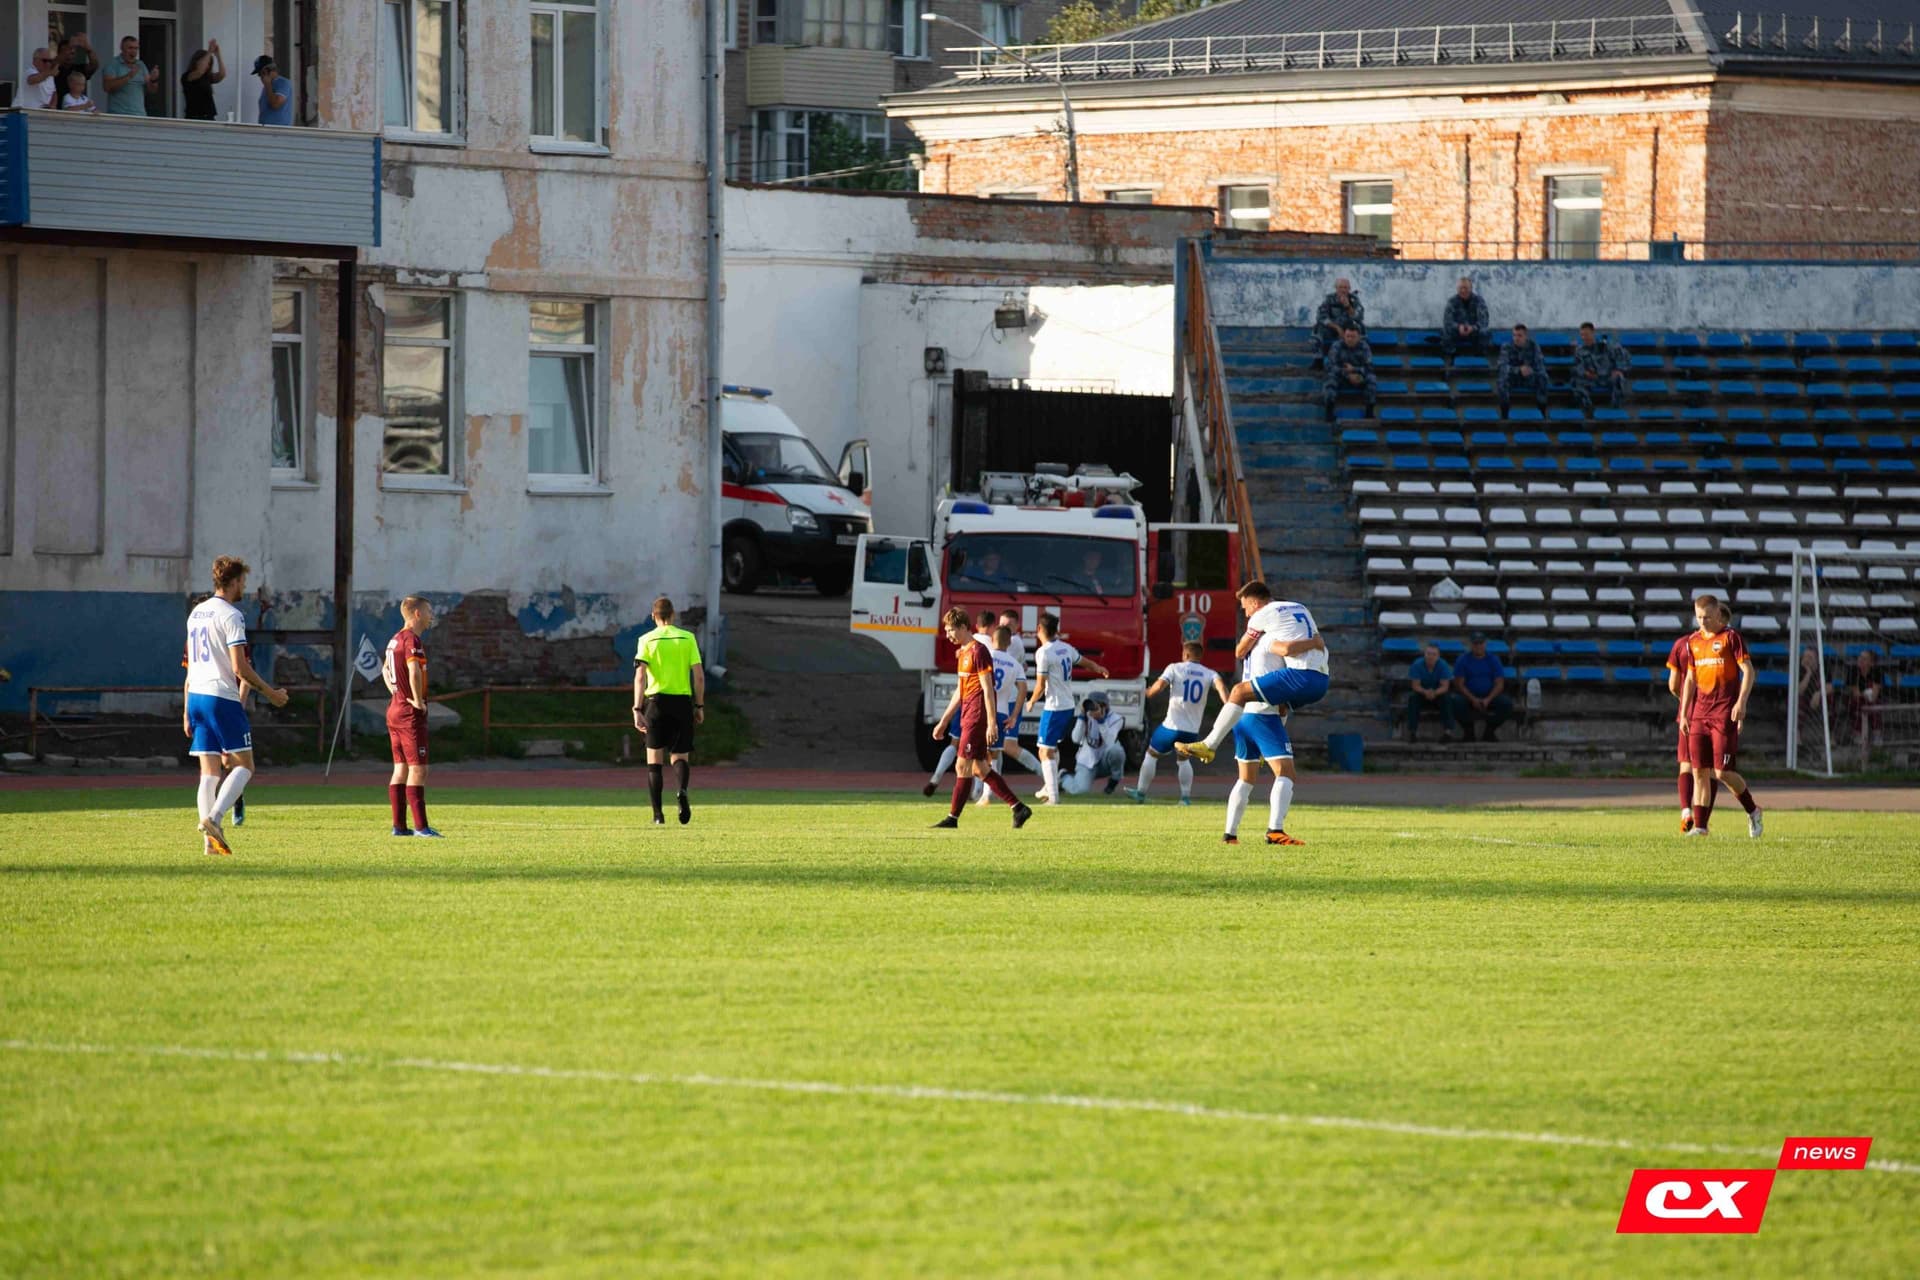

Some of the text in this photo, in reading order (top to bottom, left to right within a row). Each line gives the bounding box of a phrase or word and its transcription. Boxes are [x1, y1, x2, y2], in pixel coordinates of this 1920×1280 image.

[893, 596, 899, 614] 1
[1177, 593, 1211, 613] 110
[870, 614, 923, 627] БАРНАУЛ
[1292, 613, 1312, 638] 7
[190, 627, 210, 662] 13
[1182, 679, 1204, 704] 10
